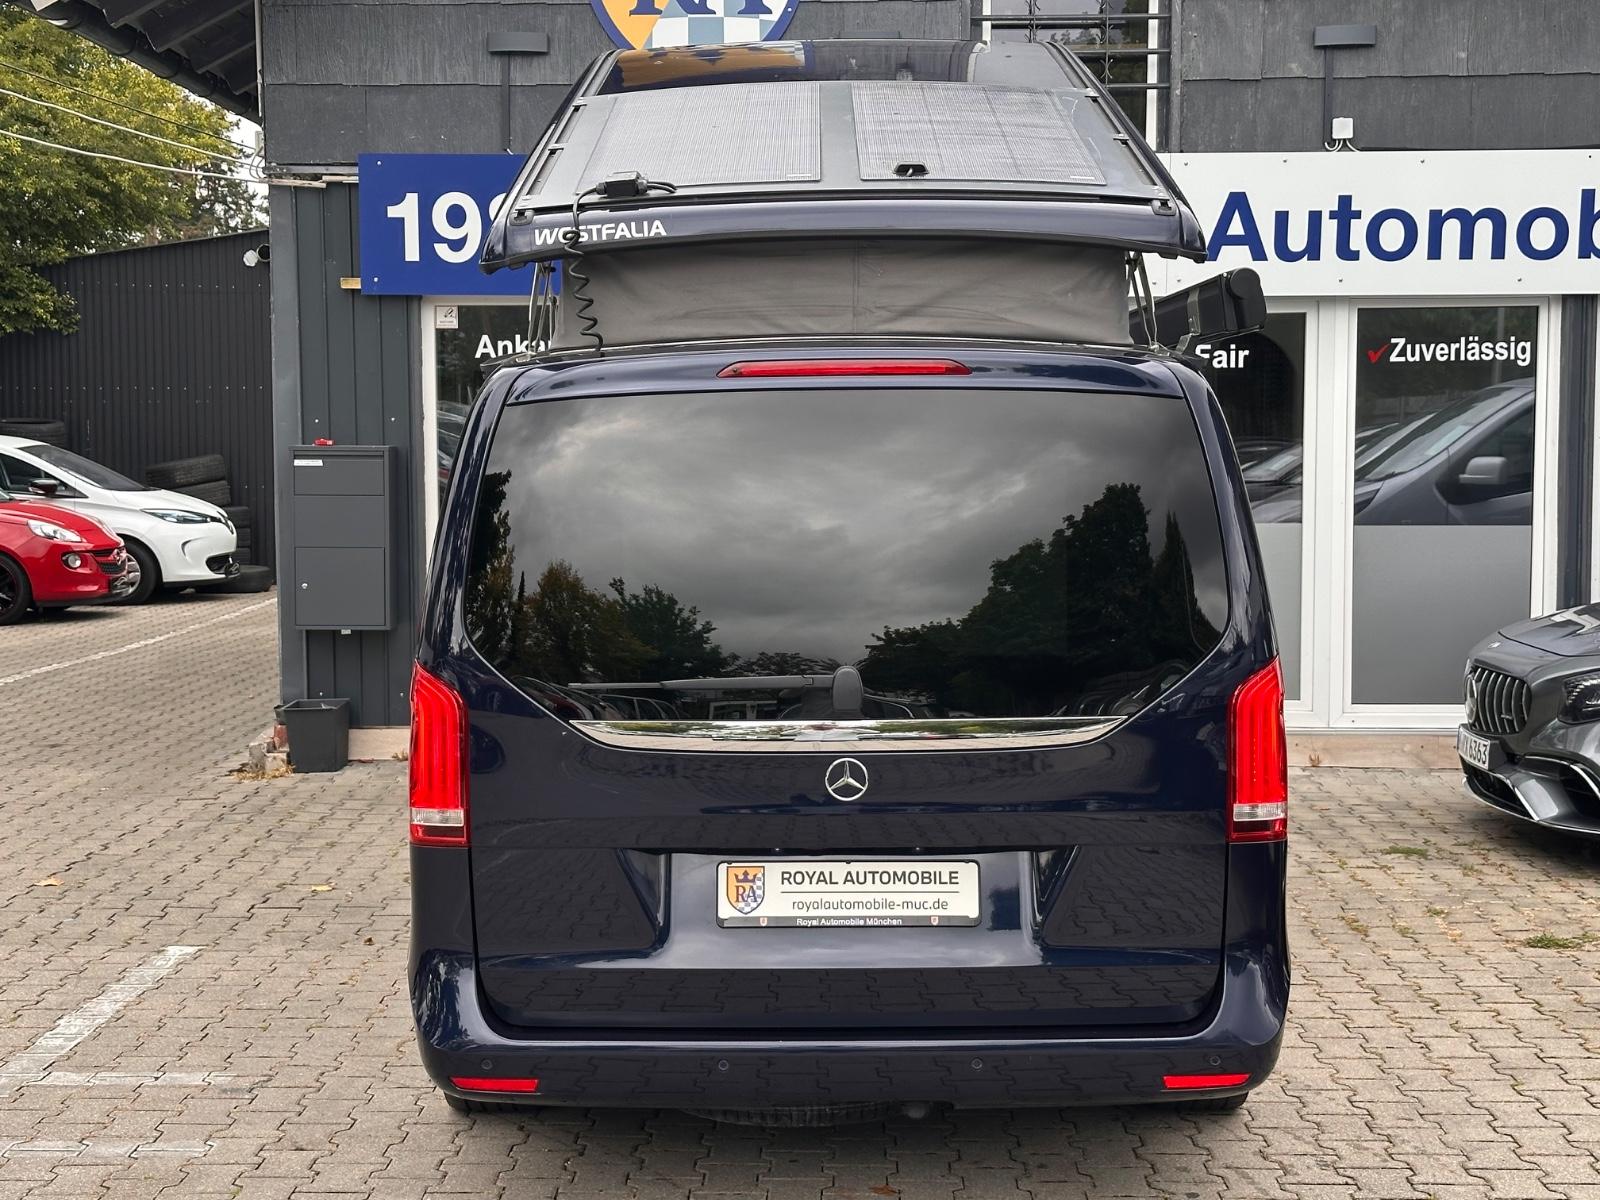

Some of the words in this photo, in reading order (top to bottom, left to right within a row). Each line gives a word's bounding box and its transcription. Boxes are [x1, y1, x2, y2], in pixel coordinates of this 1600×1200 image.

[387, 191, 507, 263] 19
[1389, 336, 1531, 367] Zuverlässig
[780, 870, 838, 885] ROYAL
[843, 870, 959, 885] AUTOMOBILE
[735, 884, 758, 903] RA
[792, 897, 949, 913] royalautomobile-muc.de
[796, 918, 819, 927] Royal
[820, 918, 865, 926] Automobile
[866, 917, 903, 926] München
